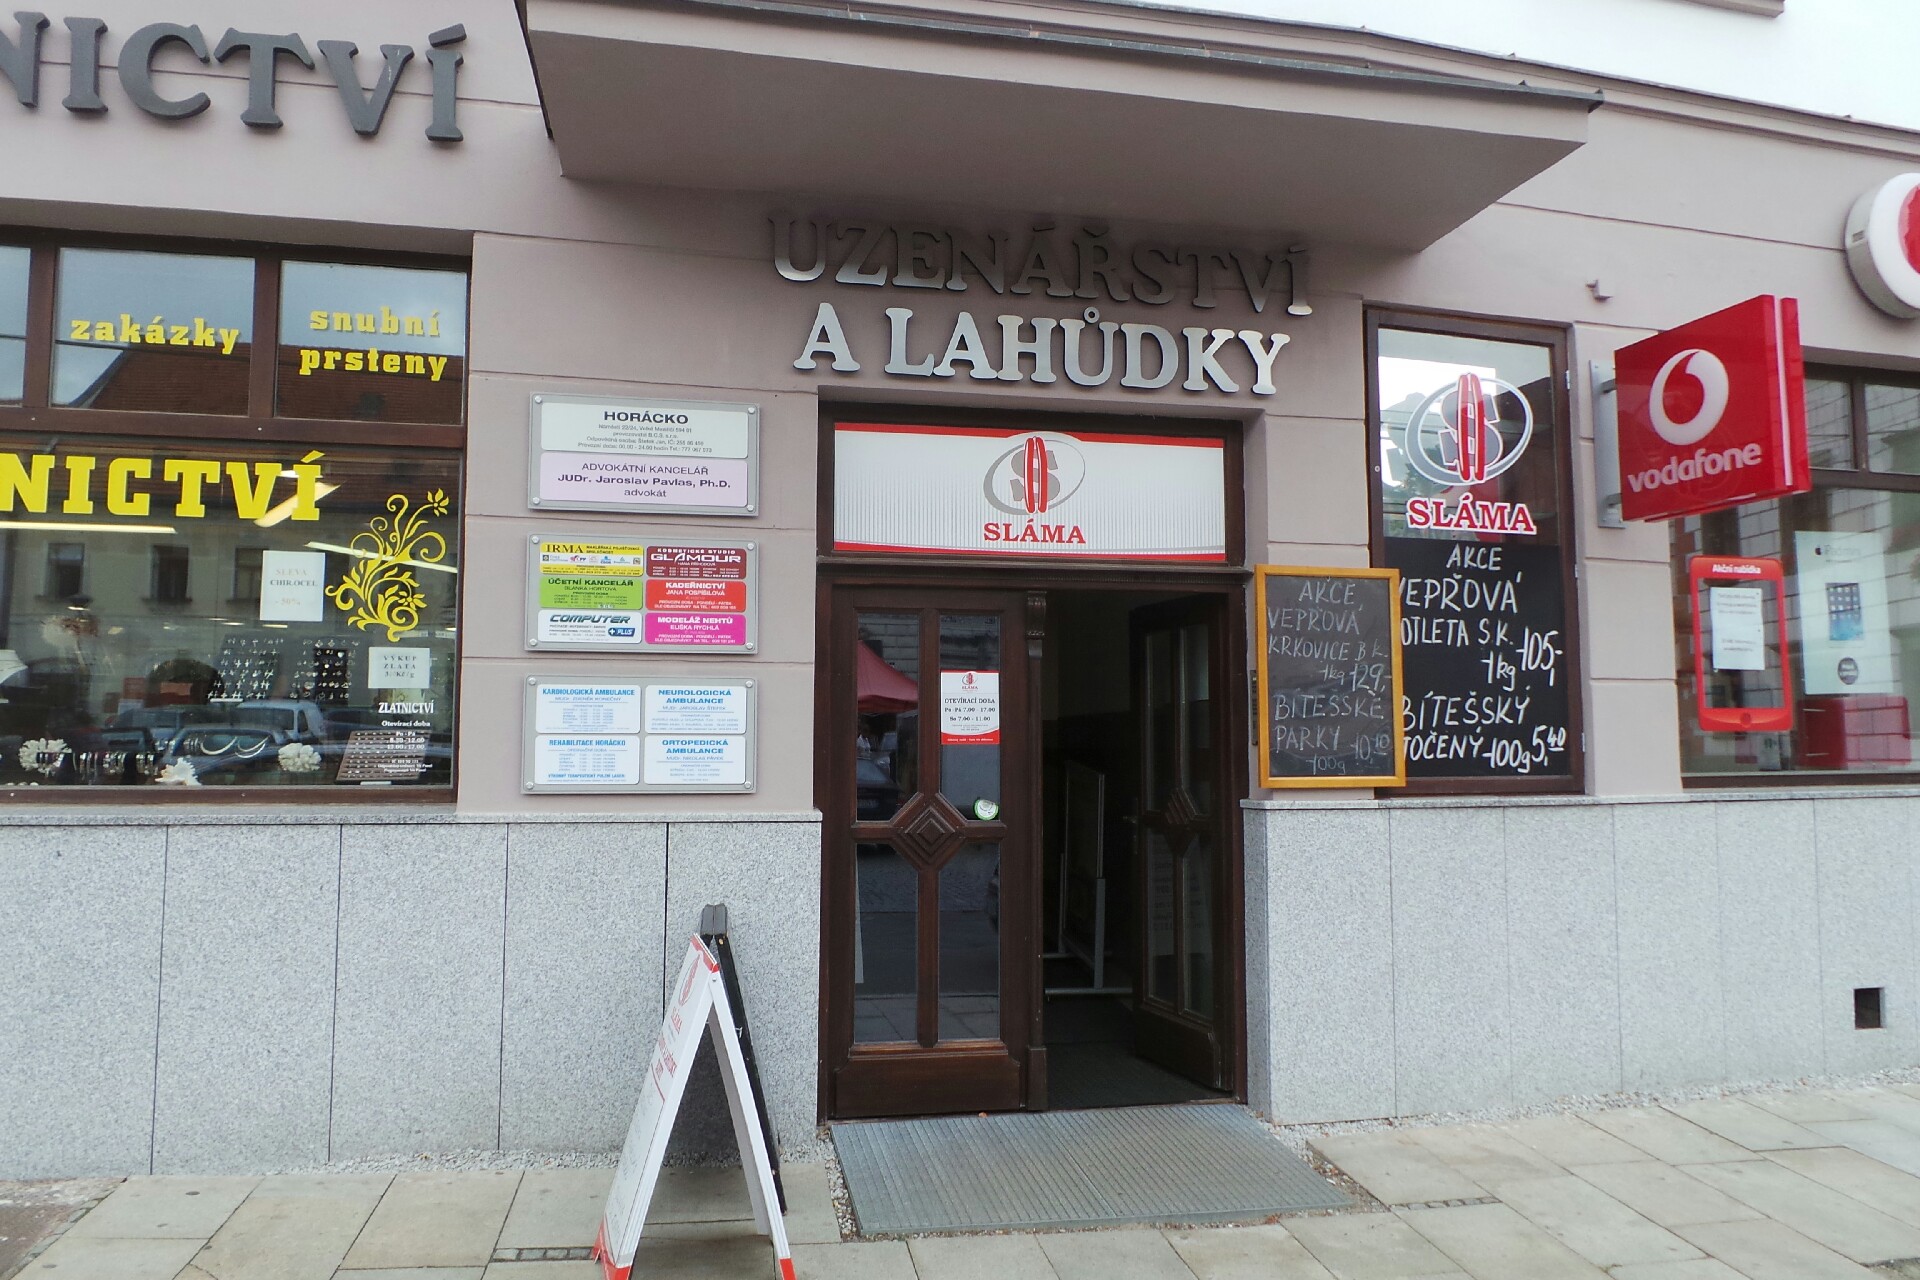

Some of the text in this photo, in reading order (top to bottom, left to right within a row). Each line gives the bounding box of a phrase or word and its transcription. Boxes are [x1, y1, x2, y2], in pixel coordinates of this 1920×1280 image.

[0, 11, 467, 142] NICTVÍ
[768, 213, 1313, 316] UZENÁŘSTVÍ
[310, 306, 441, 338] snubní
[71, 314, 241, 355] zakázky
[793, 302, 1290, 395] A LAHŮDKY
[300, 348, 447, 381] prsteny
[604, 411, 689, 424] HORÁCKO
[582, 463, 709, 476] ADVOKÁTNÍ KANCELÁŘ
[1628, 443, 1763, 493] vodafone
[0, 450, 325, 521] NICTVÍ
[558, 474, 731, 489] JUDr. Jaroslav Pavlas, Ph.D.
[624, 489, 667, 498] advokát
[1407, 493, 1536, 534] SLÁMA
[984, 518, 1086, 544] SLÁMA
[546, 544, 584, 553] IRMA
[650, 553, 742, 563] GLAMOUR
[1446, 543, 1503, 571] AKCE
[548, 577, 634, 587] ÚČETNÍ KANCELÁŘ
[666, 581, 726, 589] KADEŘNICTVÍ
[550, 614, 631, 624] COMPUTER
[703, 616, 733, 624] NEHTŮ
[1268, 635, 1349, 661] KRKOVICE
[384, 663, 416, 671] ZLATA
[542, 688, 635, 696] KARDIOLOGICKÁ AMBULANCE
[378, 700, 435, 714] ZLATNICTVÍ
[381, 719, 431, 727] Otevírací doba
[595, 738, 626, 746] HORÁCKO
